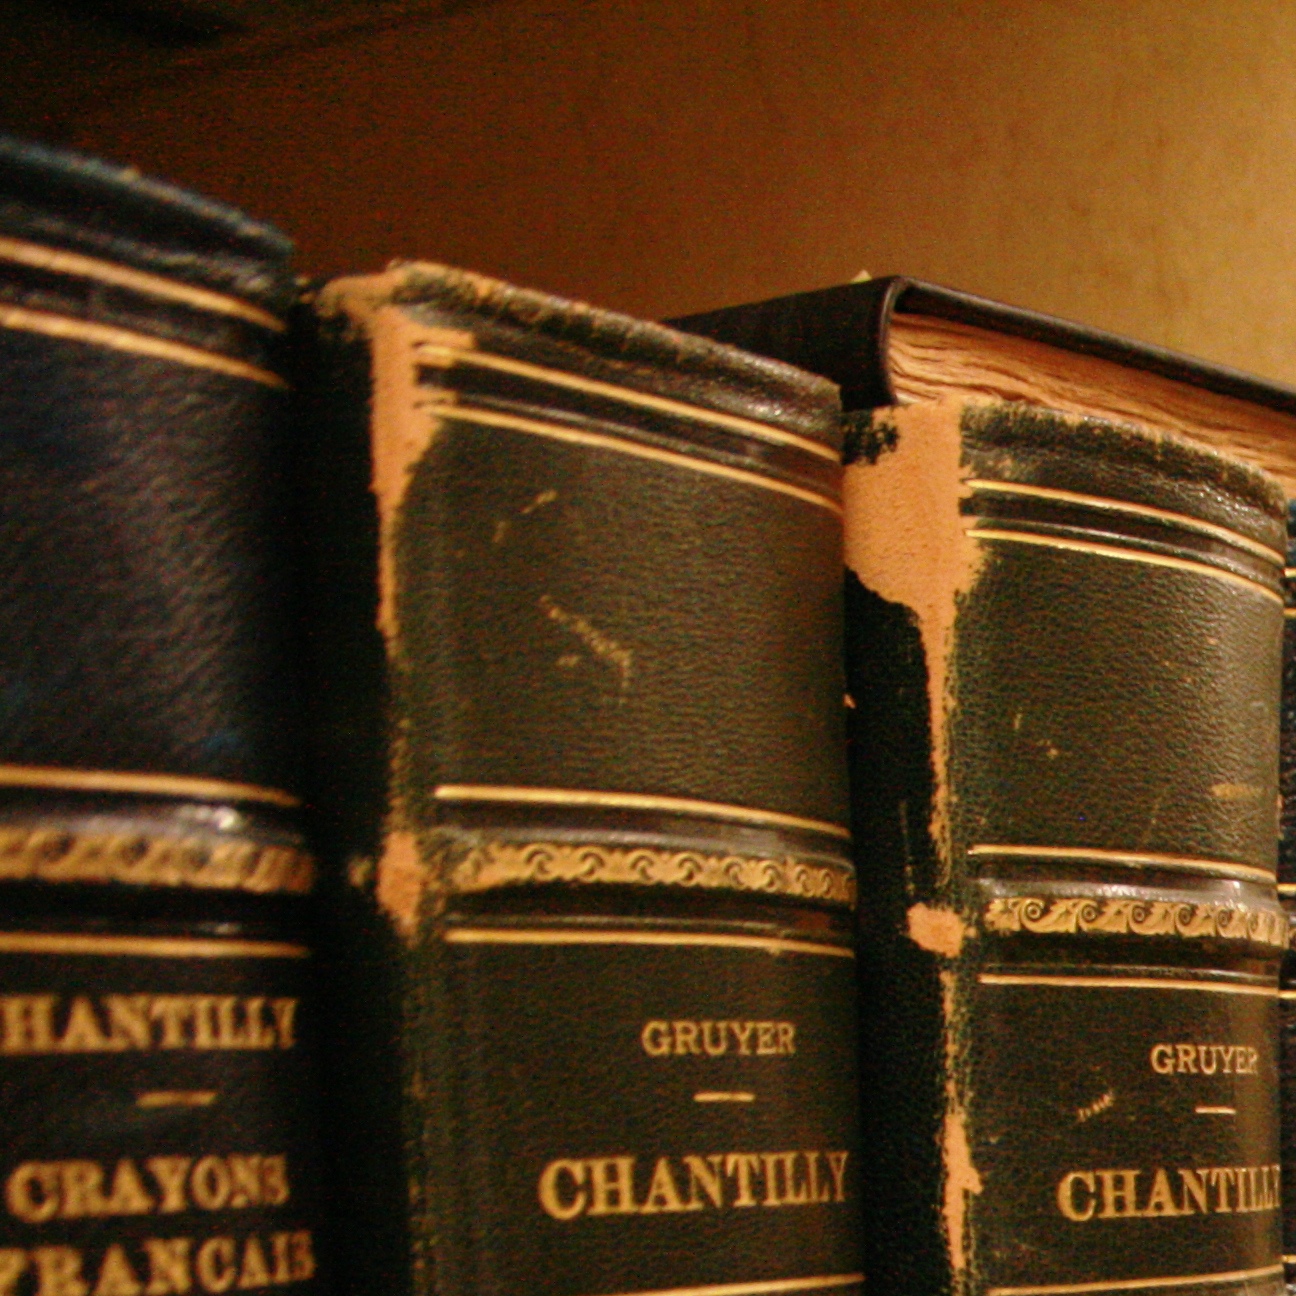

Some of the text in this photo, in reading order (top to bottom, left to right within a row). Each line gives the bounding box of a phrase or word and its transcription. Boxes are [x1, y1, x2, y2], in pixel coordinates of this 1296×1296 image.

[641, 1020, 796, 1056] GRUYER
[1150, 1042, 1258, 1075] GRUYER
[6, 1154, 290, 1224] CRAYONS
[537, 1151, 848, 1221] CHANTILLY
